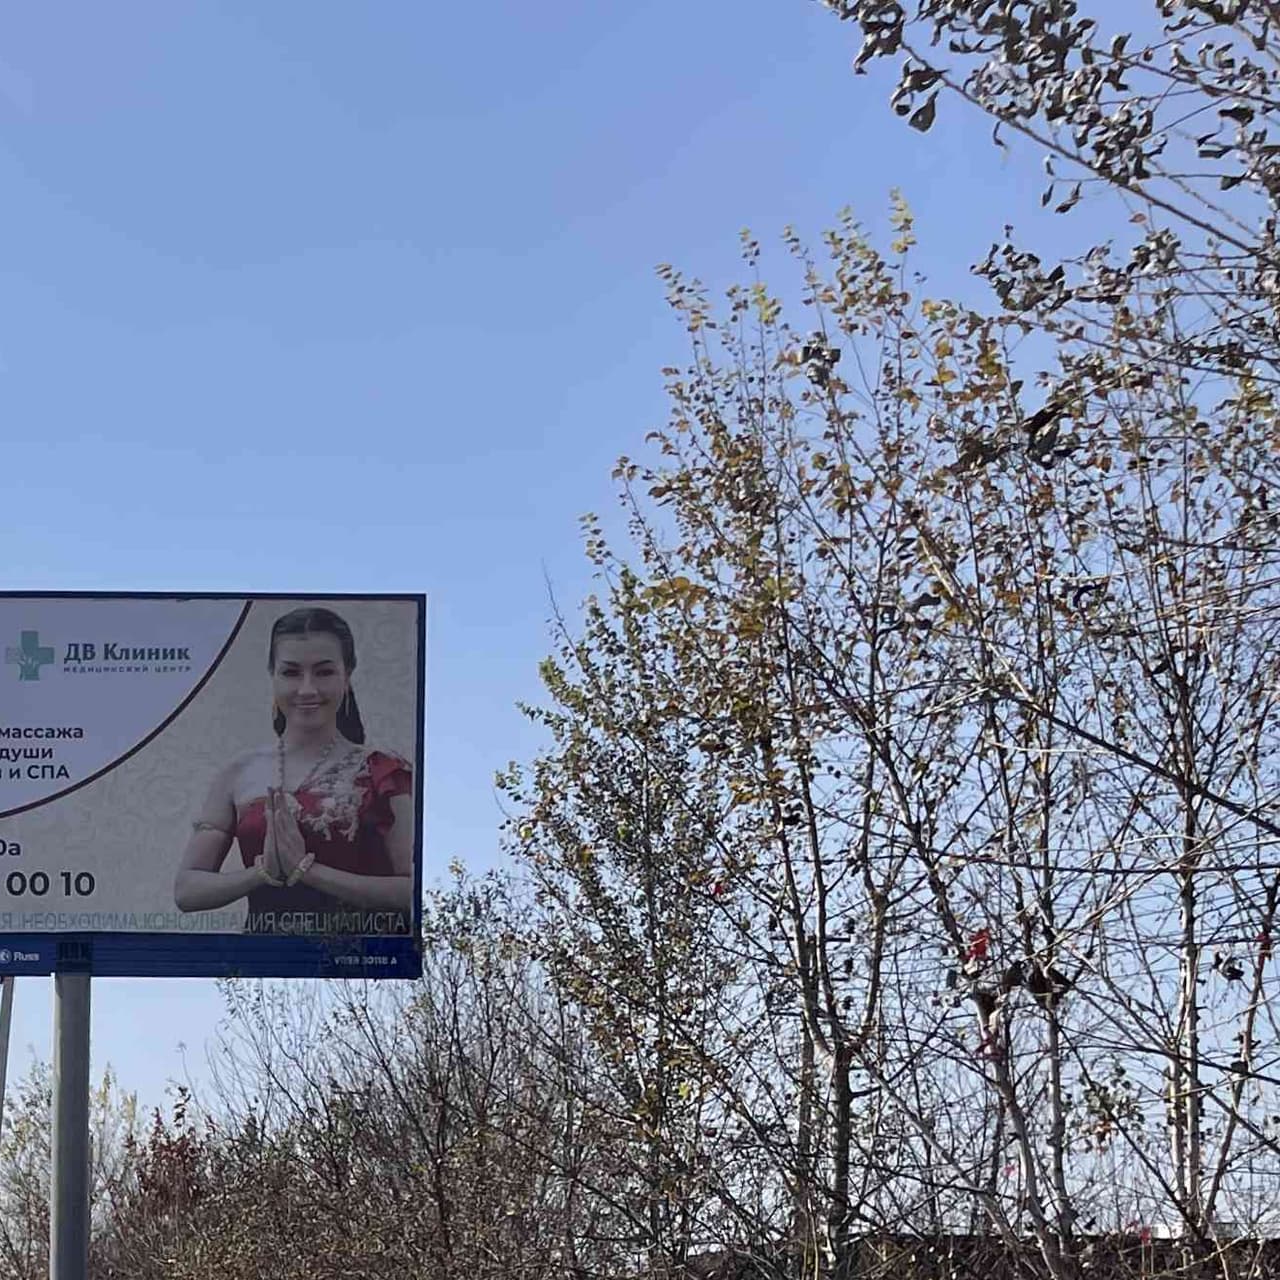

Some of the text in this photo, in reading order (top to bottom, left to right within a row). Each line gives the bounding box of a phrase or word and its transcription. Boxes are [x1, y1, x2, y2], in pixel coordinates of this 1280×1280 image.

[63, 643, 192, 664] ДВ Клиник
[8, 767, 21, 779] и
[27, 764, 70, 779] СПА
[6, 871, 50, 897] 00
[60, 871, 96, 897] 10
[279, 912, 406, 932] СПЕЦИАЛИСТА
